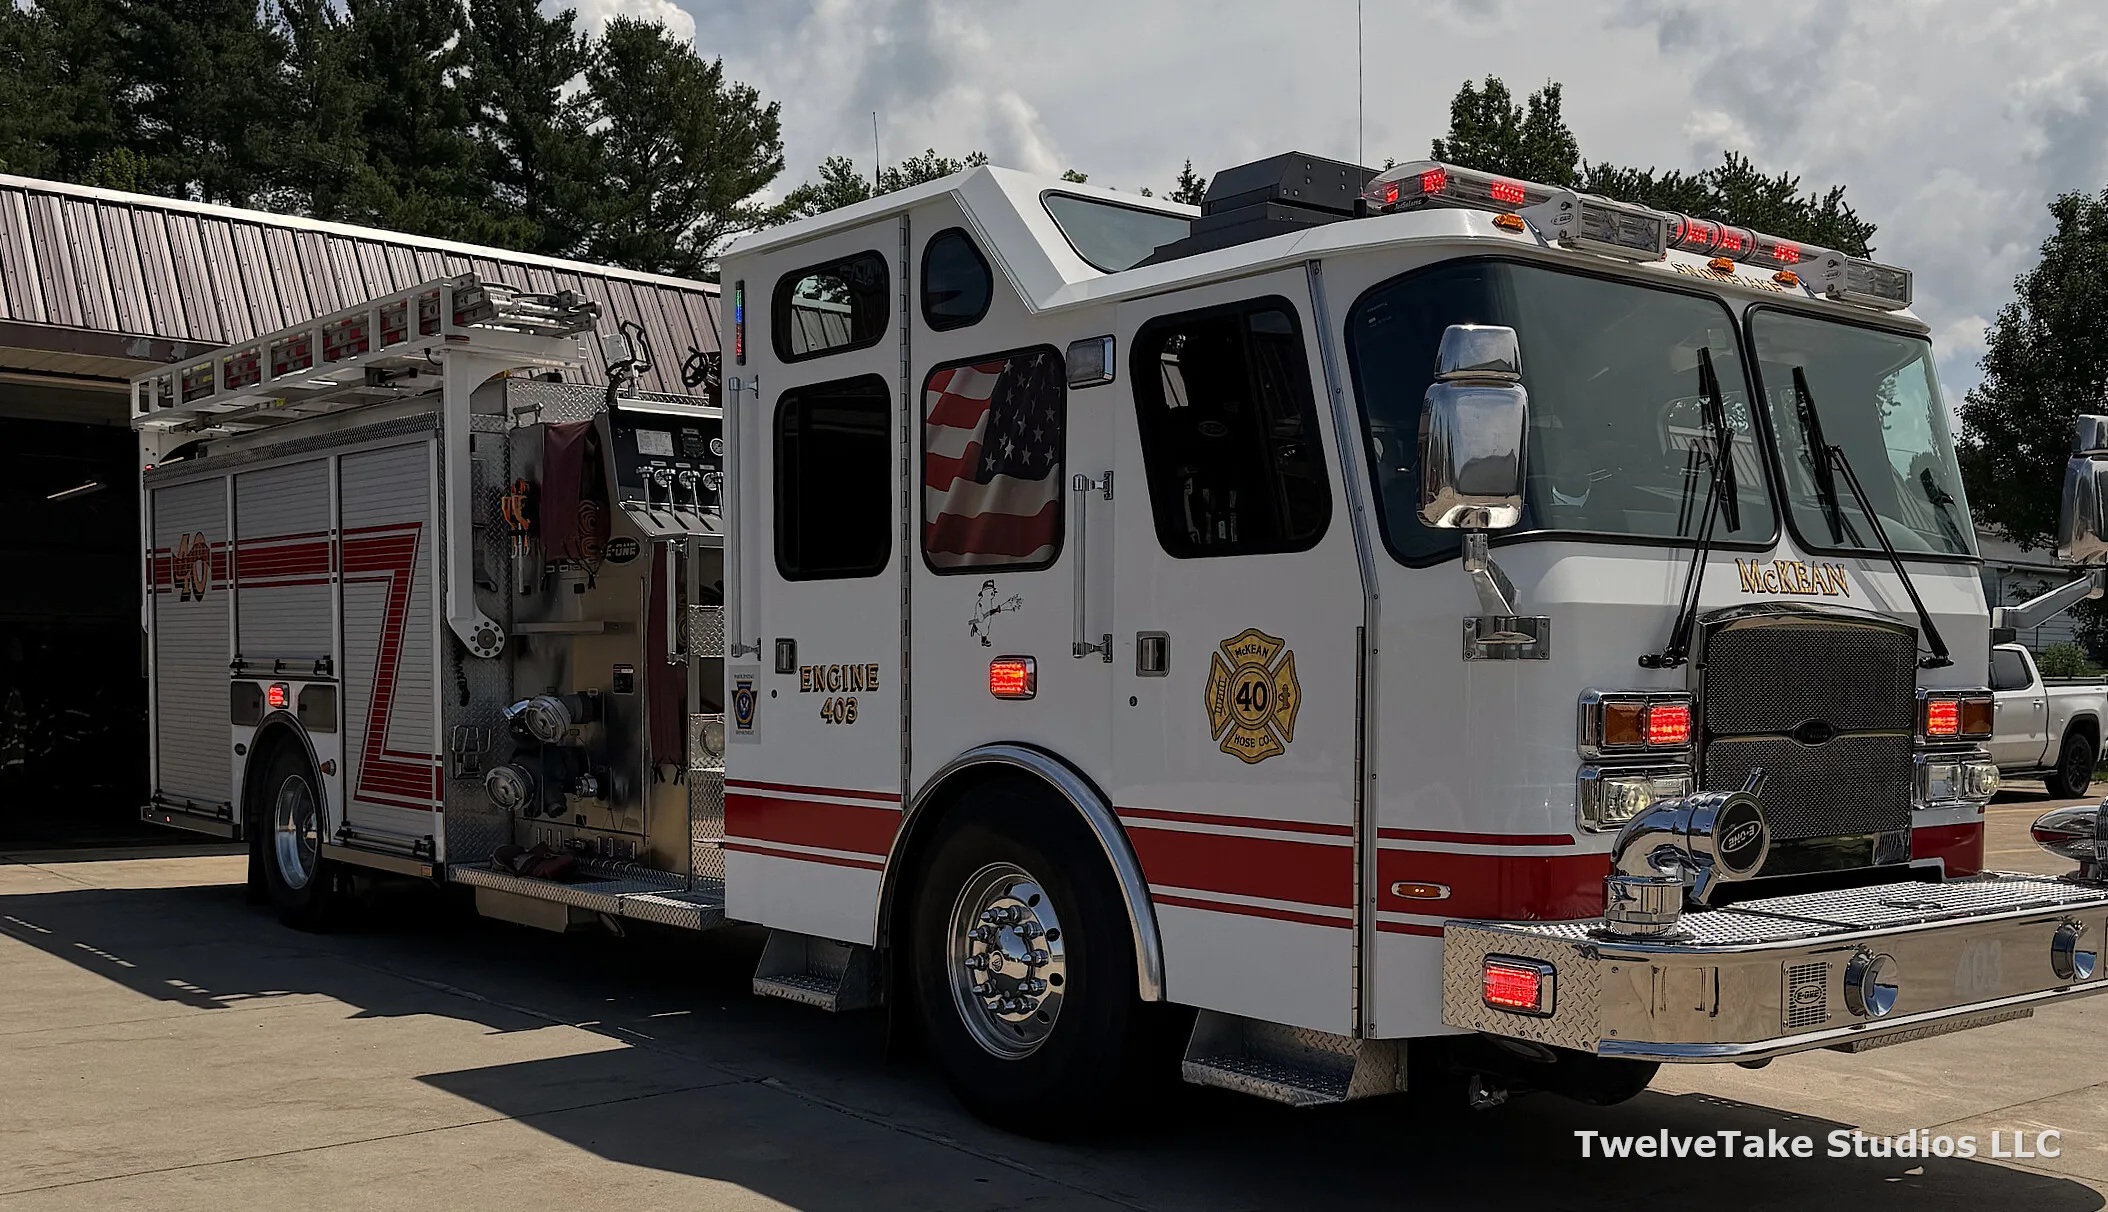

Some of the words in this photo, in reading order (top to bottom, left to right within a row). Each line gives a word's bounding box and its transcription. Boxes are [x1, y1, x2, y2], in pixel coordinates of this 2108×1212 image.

[1734, 557, 1851, 599] McKEAN
[1234, 643, 1270, 659] McKEAN
[799, 663, 880, 693] ENGINE
[820, 696, 859, 725] 403
[1235, 680, 1268, 712] 40
[1233, 733, 1256, 748] HOSE
